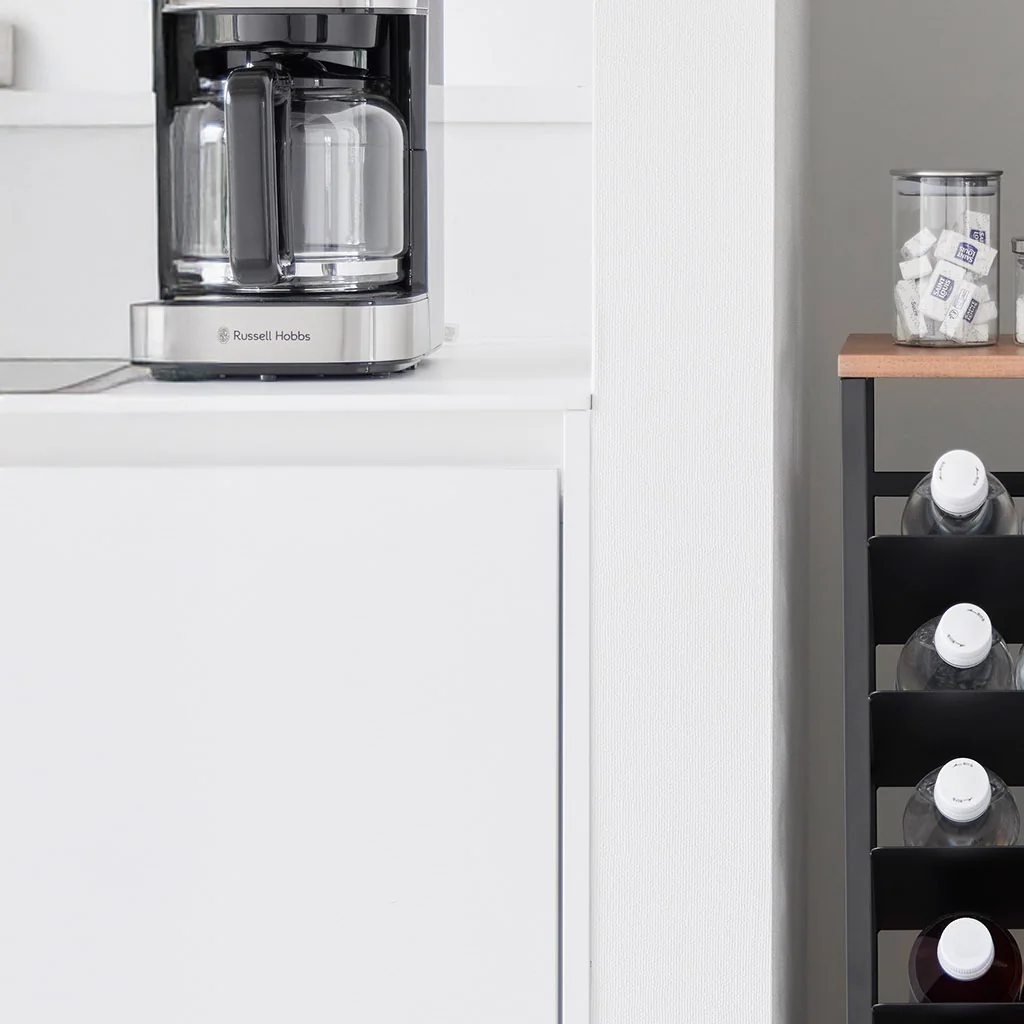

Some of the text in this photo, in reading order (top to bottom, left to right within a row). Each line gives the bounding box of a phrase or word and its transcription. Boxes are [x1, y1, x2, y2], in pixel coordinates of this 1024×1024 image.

[957, 251, 973, 263] SAINT
[960, 246, 976, 257] LOUIS
[932, 276, 945, 297] SAINT
[938, 279, 951, 299] LOUIS
[233, 330, 311, 341] Russell Hobbs
